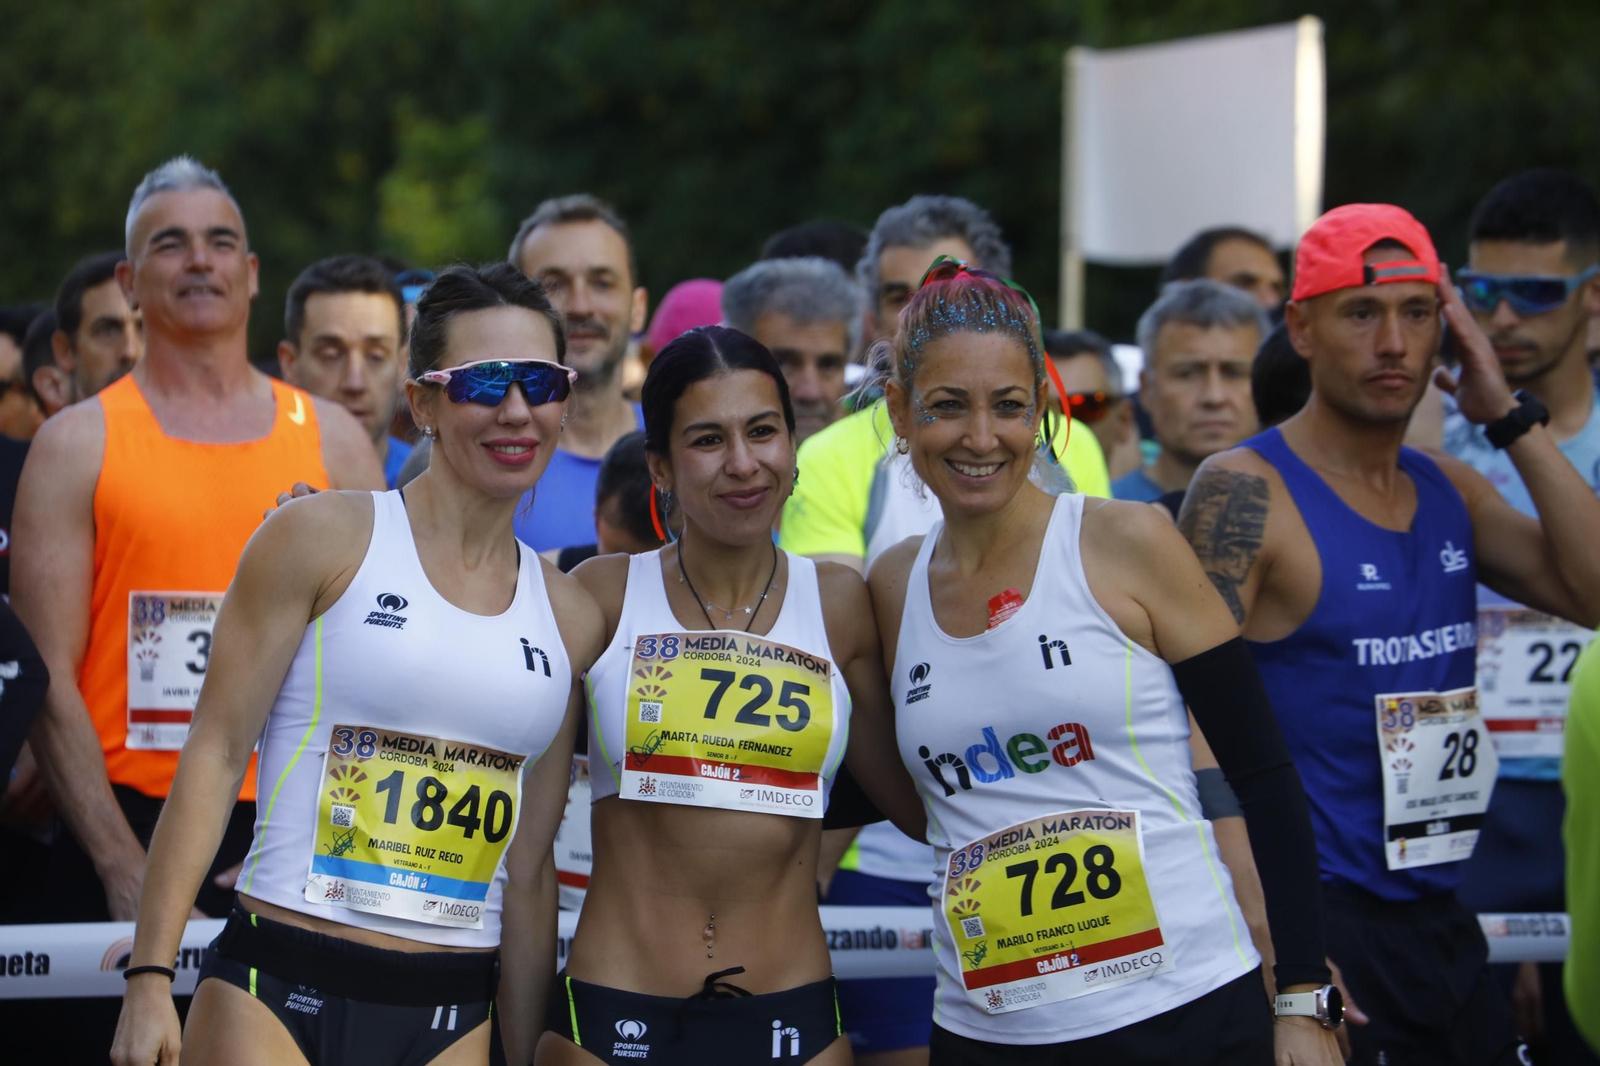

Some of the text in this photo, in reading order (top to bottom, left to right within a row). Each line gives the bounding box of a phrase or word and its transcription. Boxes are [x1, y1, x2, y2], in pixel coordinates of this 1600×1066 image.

[133, 597, 216, 626] 38 MEDIA
[368, 611, 407, 623] SPORTING
[637, 636, 827, 676] 38 MEDIA MARATÓN
[736, 655, 761, 667] 2024
[700, 668, 811, 732] 725
[333, 729, 520, 772] 38 MEDIA MARATÓN
[661, 730, 793, 757] MARTA RUEDA FERNANDEZ
[707, 751, 724, 759] SENIOR
[918, 722, 1096, 797] indea
[1438, 729, 1479, 781] 28
[432, 760, 455, 773] 2024
[701, 763, 740, 781] CAJÓN 2
[659, 780, 704, 792] AYUNTAMIENTO
[375, 769, 513, 843] 1840
[756, 789, 813, 807] IMDECO
[368, 838, 463, 865] MARIBEL RUIZ RECIO
[951, 813, 1131, 877] 38 MEDIA MARATÓN
[1035, 836, 1060, 850] 2024
[393, 859, 418, 868] VETERANO
[389, 872, 420, 889] CAJÓN
[1006, 844, 1122, 917] 728
[346, 894, 352, 903] DE
[347, 886, 390, 901] AYUNTAMIENTO
[439, 902, 480, 919] IMDECO
[997, 916, 1111, 949] MARILO FRANCO LUQUE
[1033, 944, 1059, 953] VETERANO
[1036, 954, 1080, 974] CAJÓN 2
[1101, 952, 1162, 978] IMDECO
[1004, 982, 1047, 997] AYUNTAMIENTO
[284, 1000, 320, 1016] PURSUITS
[288, 992, 324, 1008] SPORTING
[1004, 997, 1013, 1005] DE
[612, 1049, 647, 1059] PURSUITS
[613, 1042, 650, 1051] SPORTING
